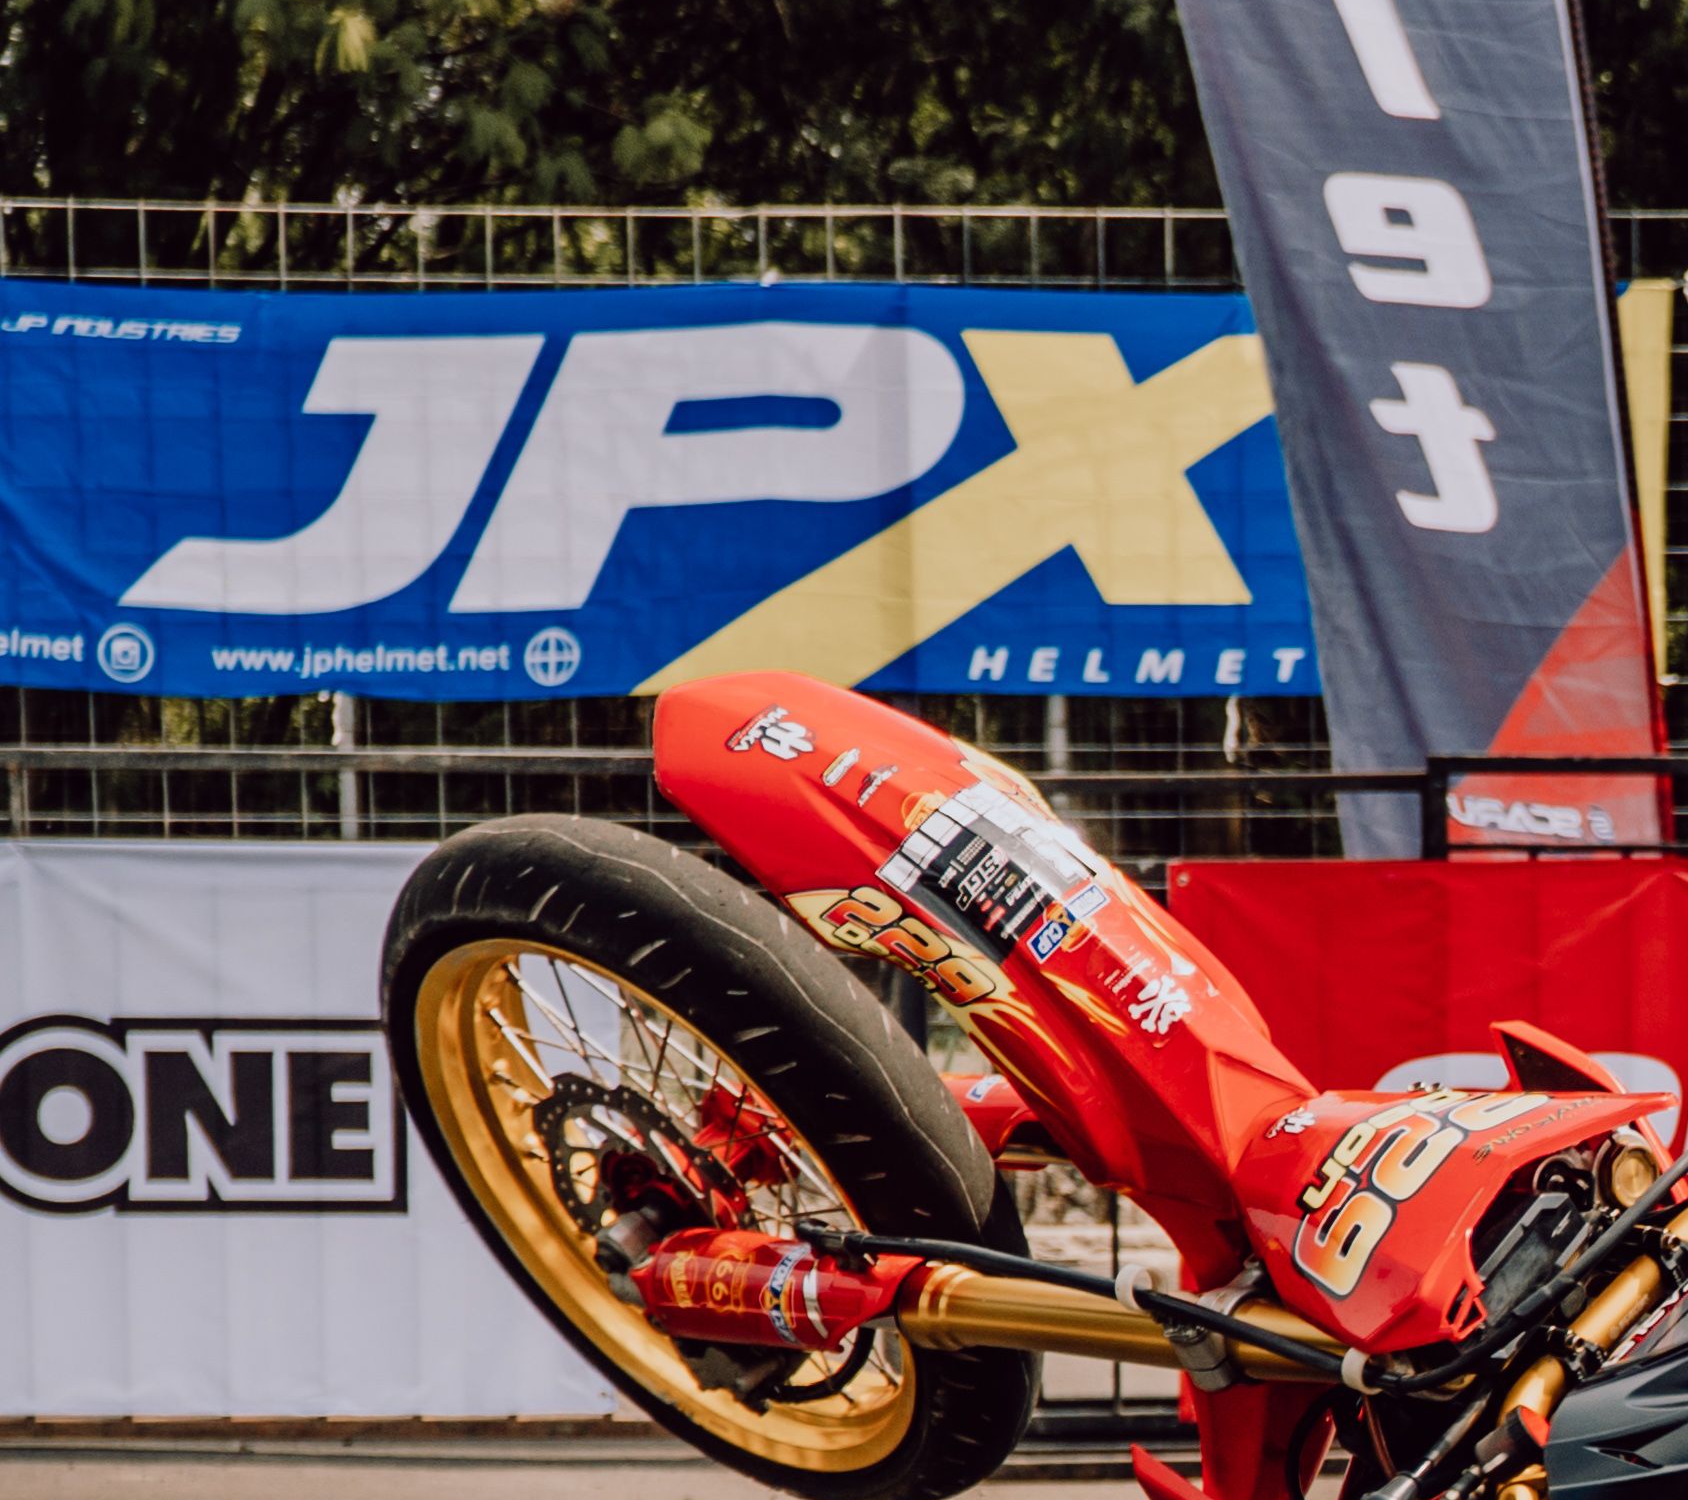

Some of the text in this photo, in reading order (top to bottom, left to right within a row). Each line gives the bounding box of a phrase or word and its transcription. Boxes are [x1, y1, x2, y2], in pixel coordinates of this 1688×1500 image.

[51, 314, 242, 344] INDUSTRIES
[118, 320, 1277, 697] JPX
[211, 641, 511, 678] www.jphelmet.net
[967, 645, 1307, 687] HELMET
[821, 886, 996, 1006] 229
[1036, 921, 1064, 956] CUP
[0, 1032, 392, 1198] ONE
